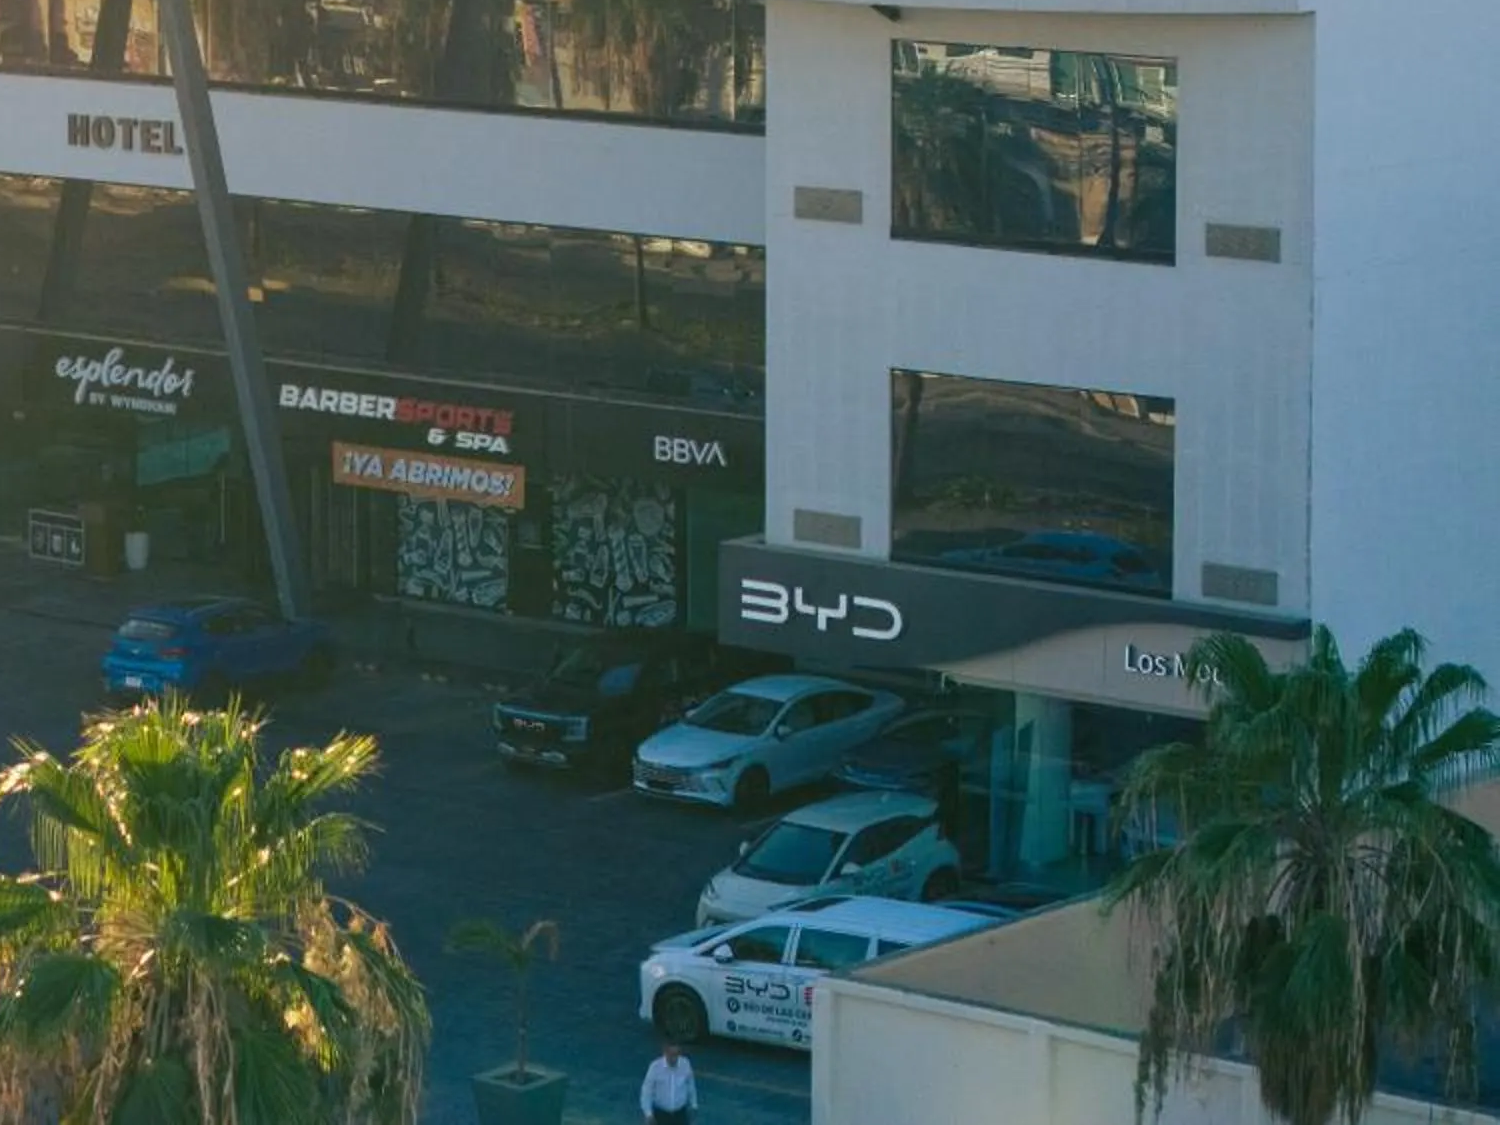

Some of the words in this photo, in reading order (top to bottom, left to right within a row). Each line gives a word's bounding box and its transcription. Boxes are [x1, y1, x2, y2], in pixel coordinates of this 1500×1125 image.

[67, 113, 184, 155] HOTEL
[55, 346, 196, 405] esplendor
[455, 430, 510, 454] SPA
[654, 435, 727, 467] BBVA
[389, 458, 515, 496] ABRIMOS!
[741, 578, 903, 641] BYD
[1125, 643, 1167, 676] Los
[725, 976, 791, 1001] BYD
